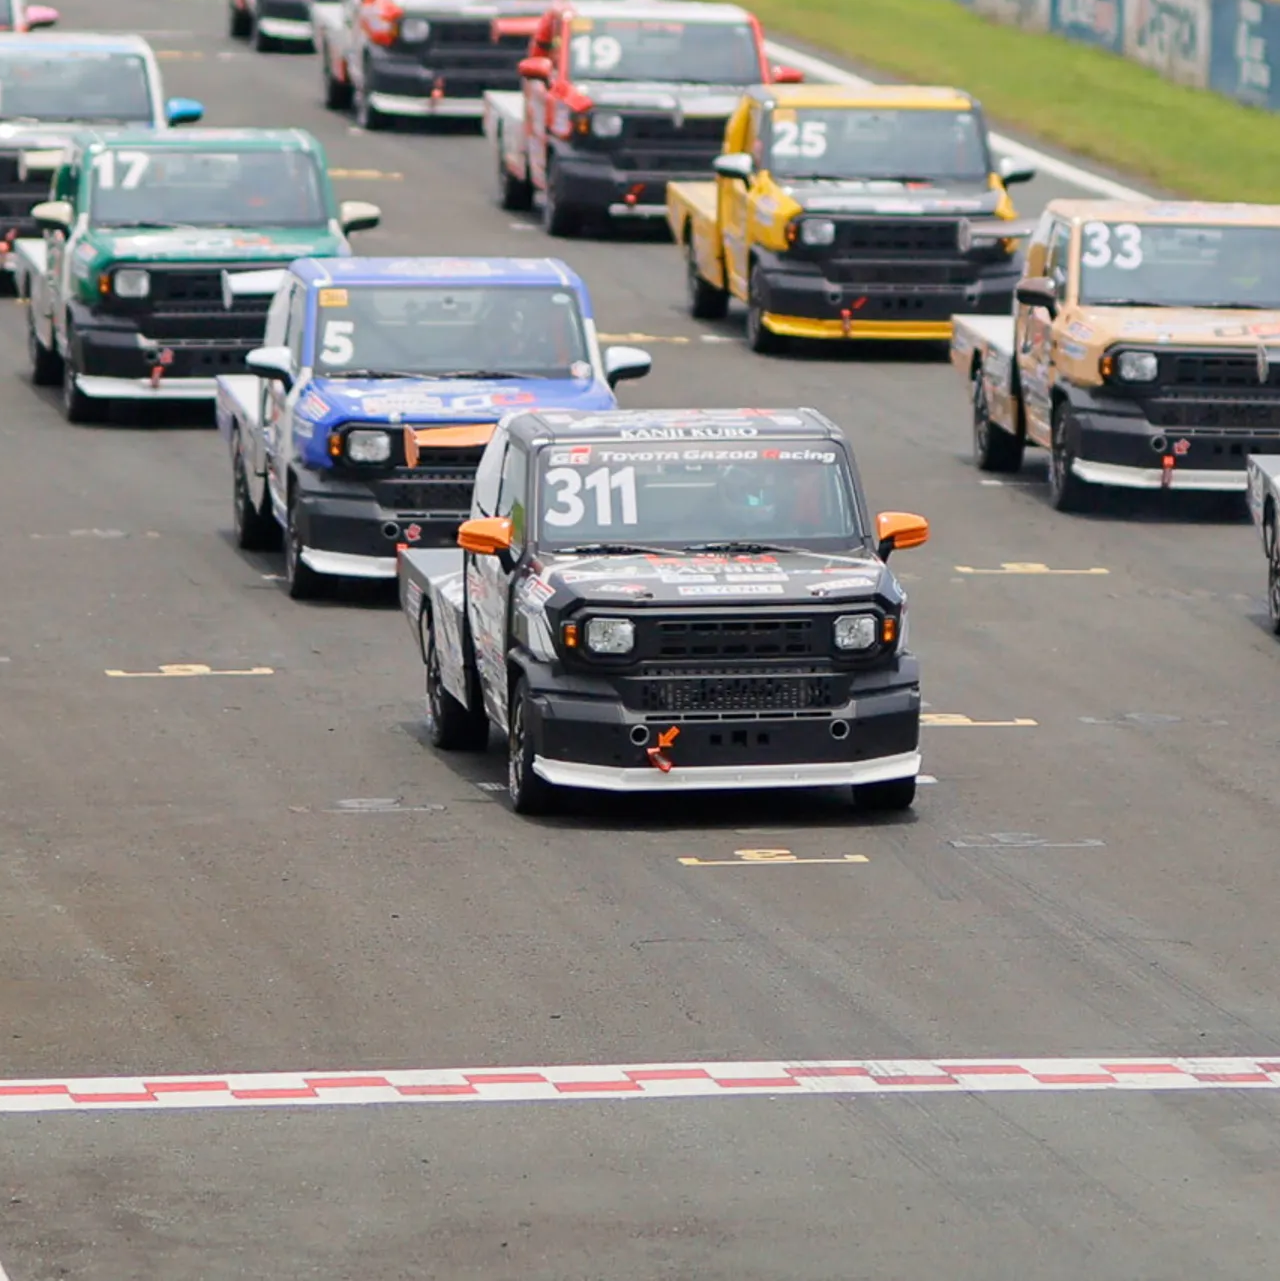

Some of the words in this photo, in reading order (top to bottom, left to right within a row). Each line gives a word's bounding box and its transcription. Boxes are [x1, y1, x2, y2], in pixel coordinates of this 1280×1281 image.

[571, 35, 621, 70] 19
[771, 122, 827, 157] 25
[91, 152, 150, 189] 17
[1082, 222, 1144, 269] 33
[321, 321, 354, 365] 5
[598, 451, 679, 462] TOYOTA
[683, 450, 757, 461] GAZOO
[762, 449, 836, 464] Racing
[544, 466, 638, 527] 311
